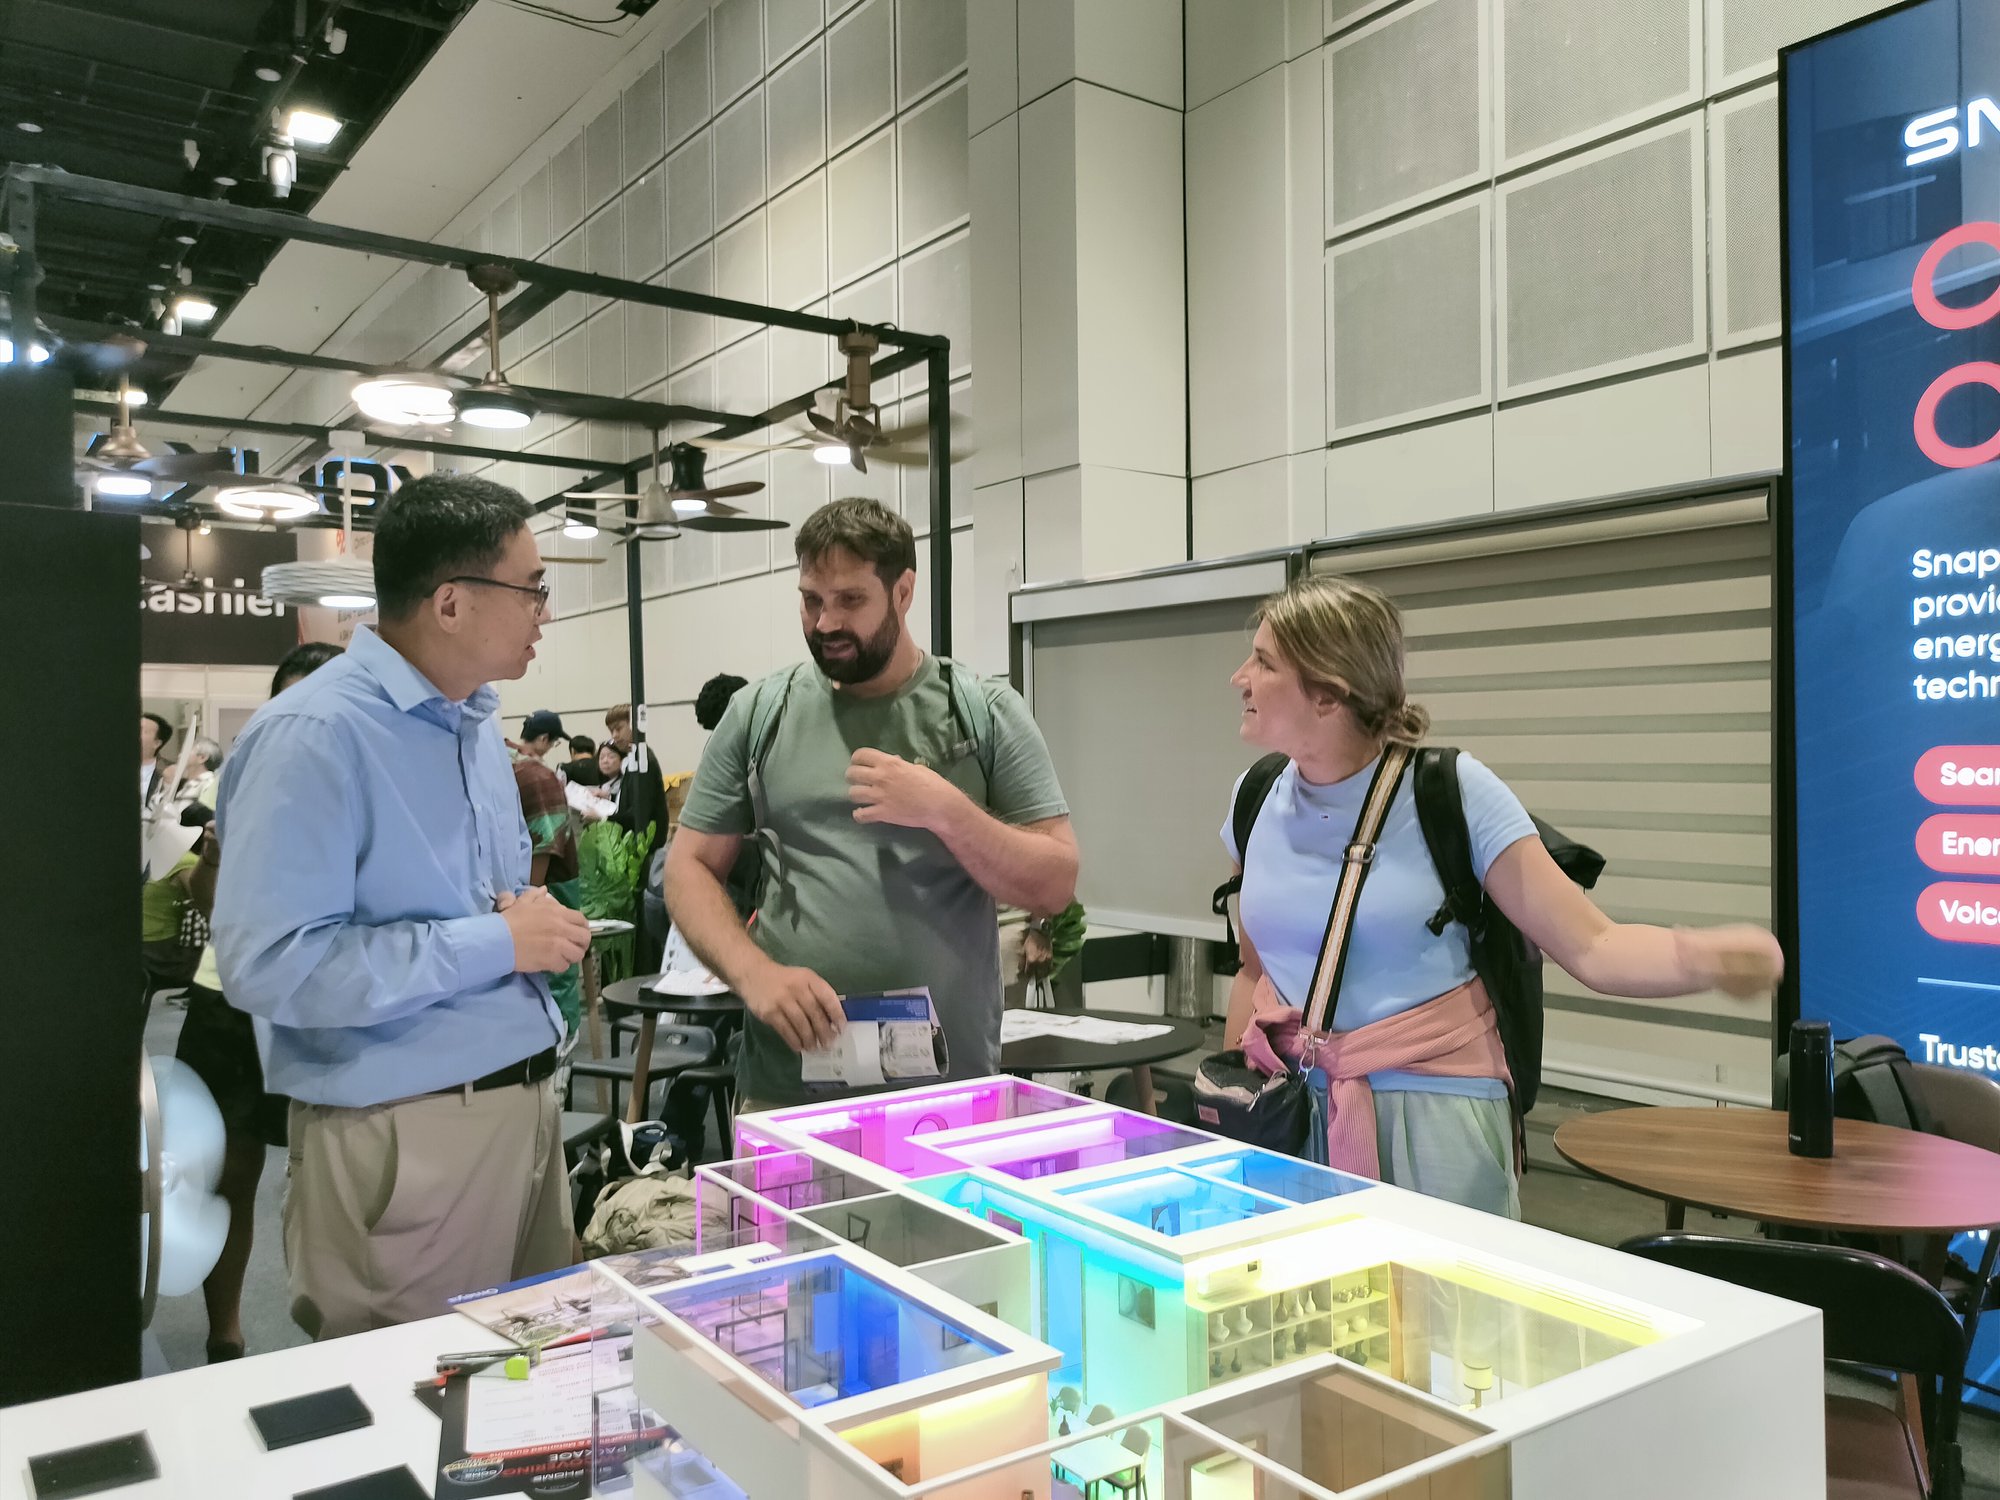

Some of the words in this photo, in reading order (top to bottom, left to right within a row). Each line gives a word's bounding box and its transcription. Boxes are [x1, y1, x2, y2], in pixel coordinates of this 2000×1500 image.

[1912, 549, 2000, 579] Snap
[141, 577, 286, 617] ashier
[1913, 584, 2000, 625] provi
[1940, 762, 2000, 786] Sea
[1939, 899, 2000, 925] Voic
[1919, 1033, 2000, 1072] Trust
